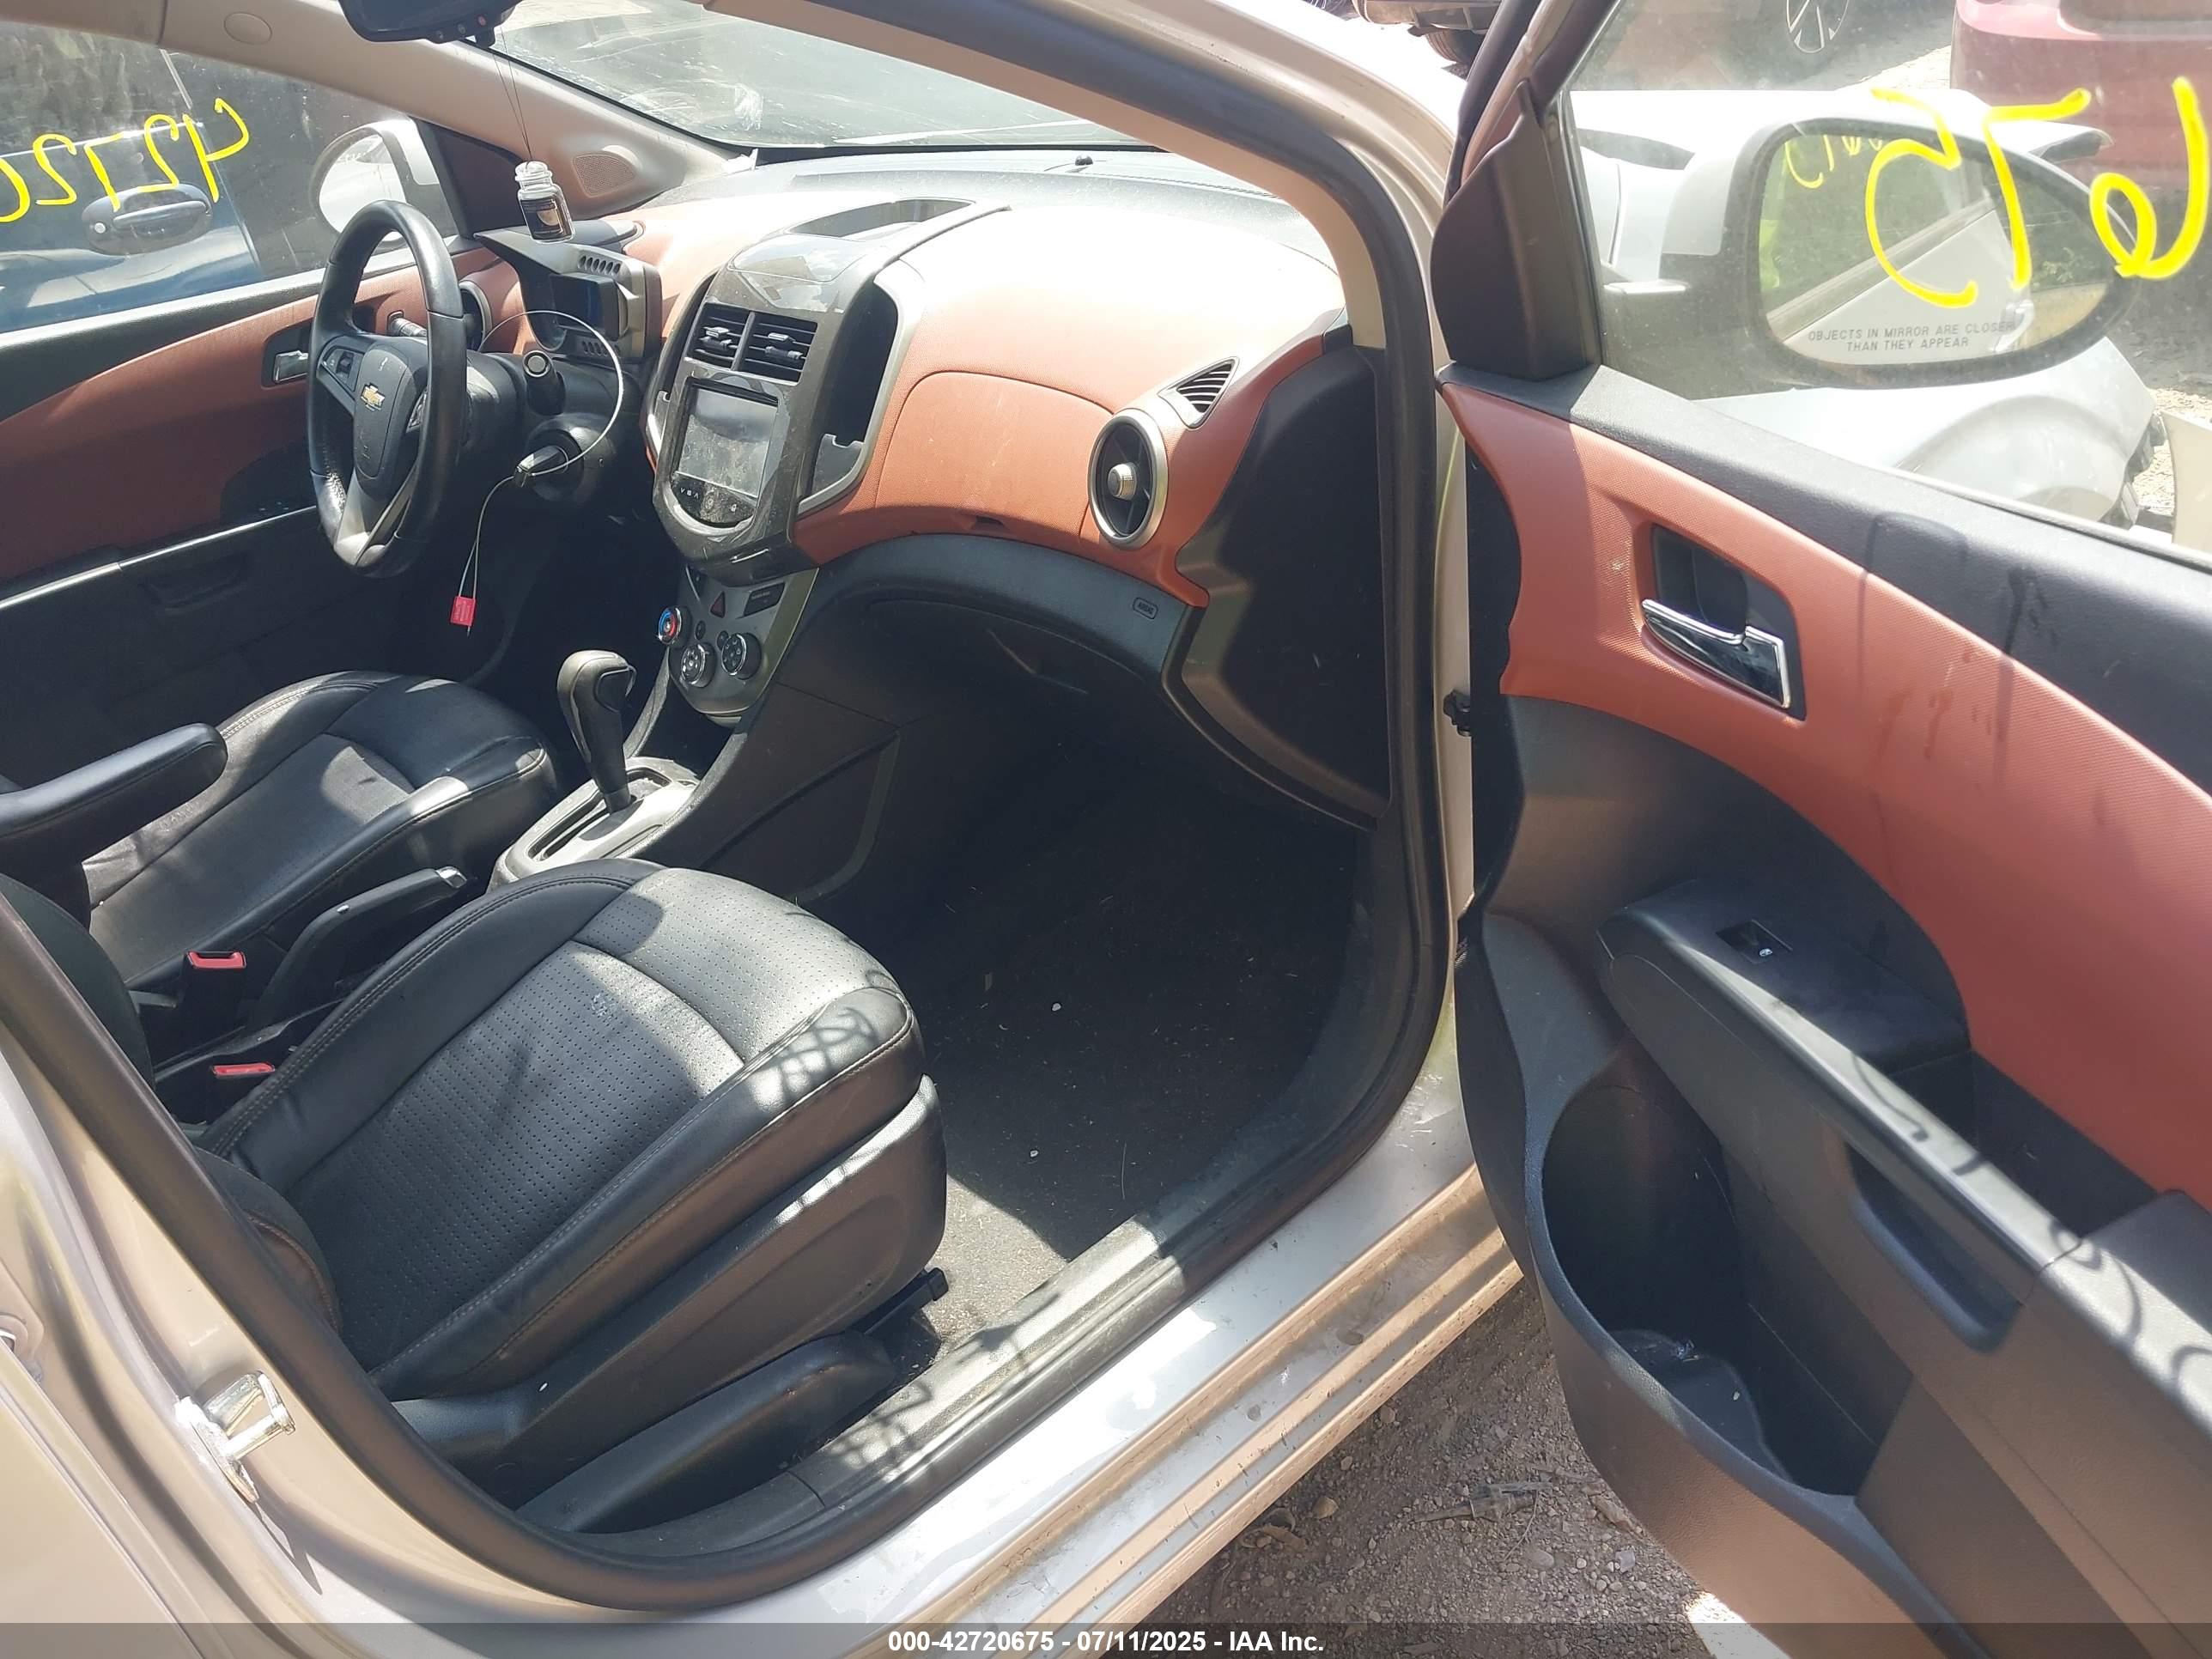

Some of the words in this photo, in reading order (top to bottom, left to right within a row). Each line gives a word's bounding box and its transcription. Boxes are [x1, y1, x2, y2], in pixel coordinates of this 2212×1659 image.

[1808, 329, 1863, 341] OBJECTS
[1867, 328, 1879, 338] IN
[1884, 325, 1929, 337] MIRROR
[1935, 325, 1959, 335] ARE
[1965, 321, 2015, 334] CLOSER
[1846, 341, 1878, 351] THAN
[1884, 339, 1915, 350] THEY
[1920, 337, 1969, 349] APPEAR
